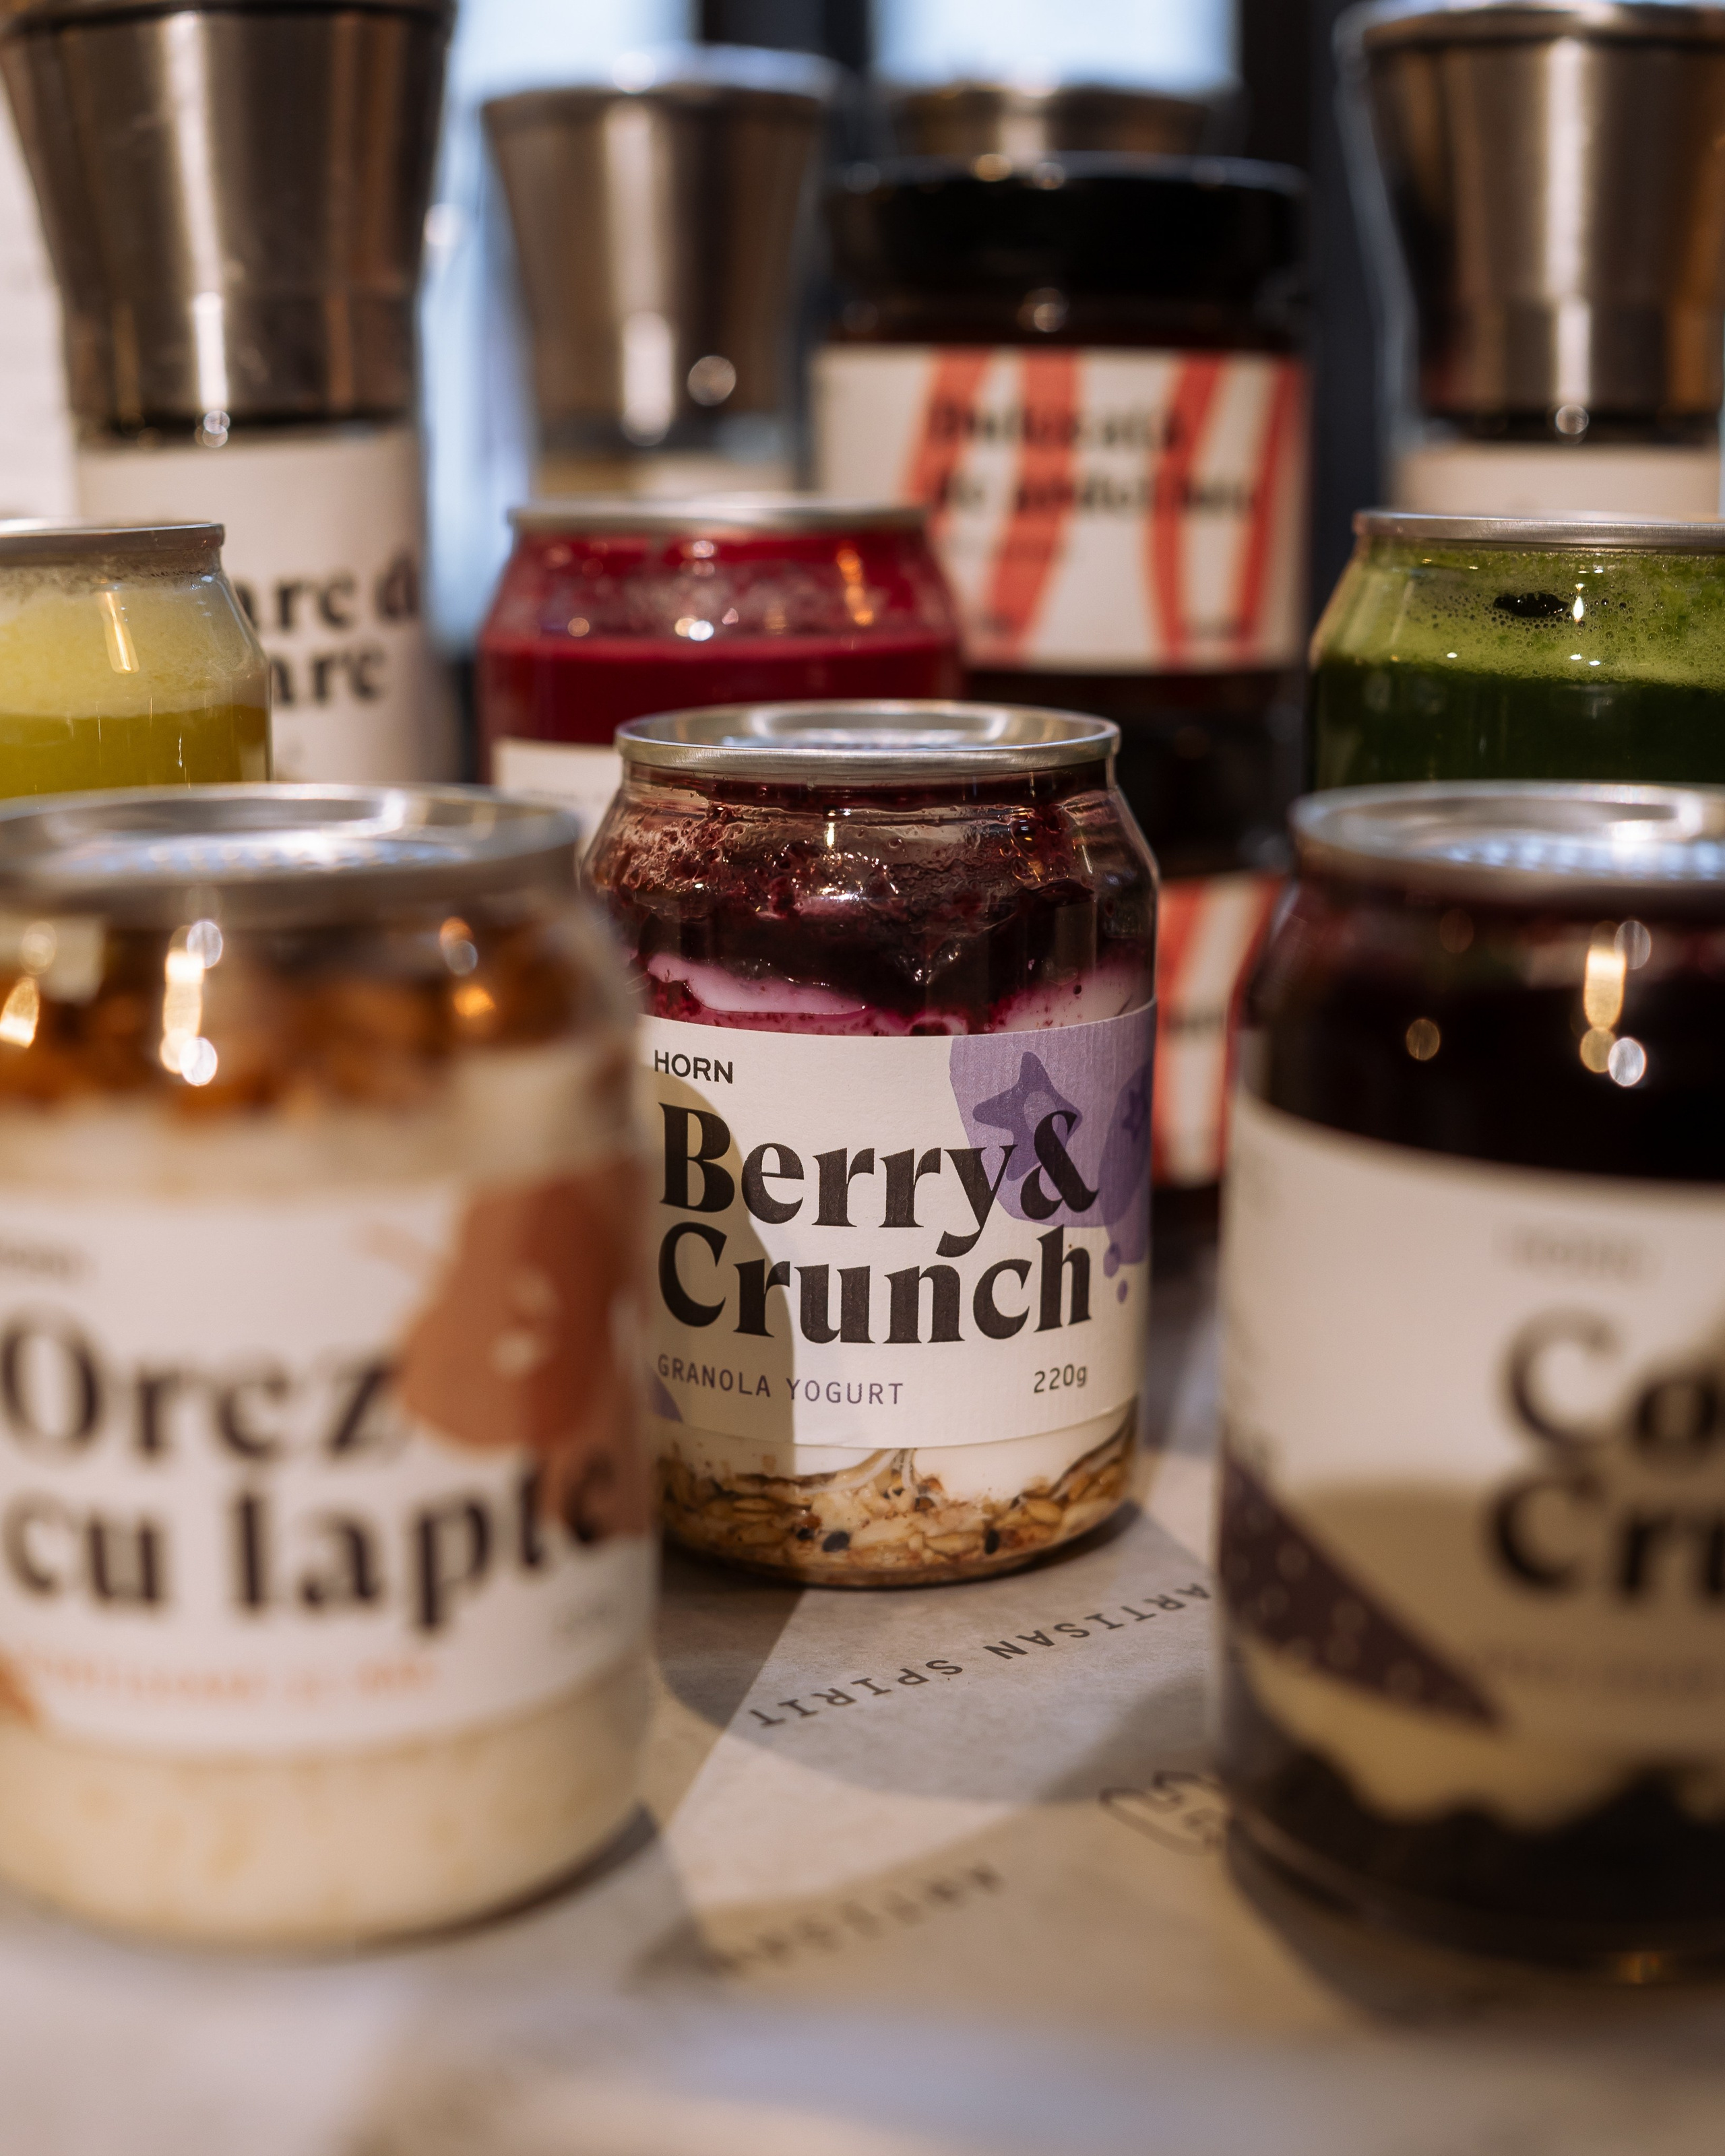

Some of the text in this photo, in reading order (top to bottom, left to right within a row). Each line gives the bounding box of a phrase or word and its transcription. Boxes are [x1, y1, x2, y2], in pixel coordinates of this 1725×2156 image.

[654, 1049, 734, 1085] HORN
[658, 1221, 1093, 1345] Crunch
[0, 1306, 406, 1459] Orez
[657, 1353, 1088, 1406] GRANOLA YOGURT 220g
[1, 1447, 617, 1641] cu lapte
[749, 1582, 1212, 1727] ARTISAN SPIRIT
